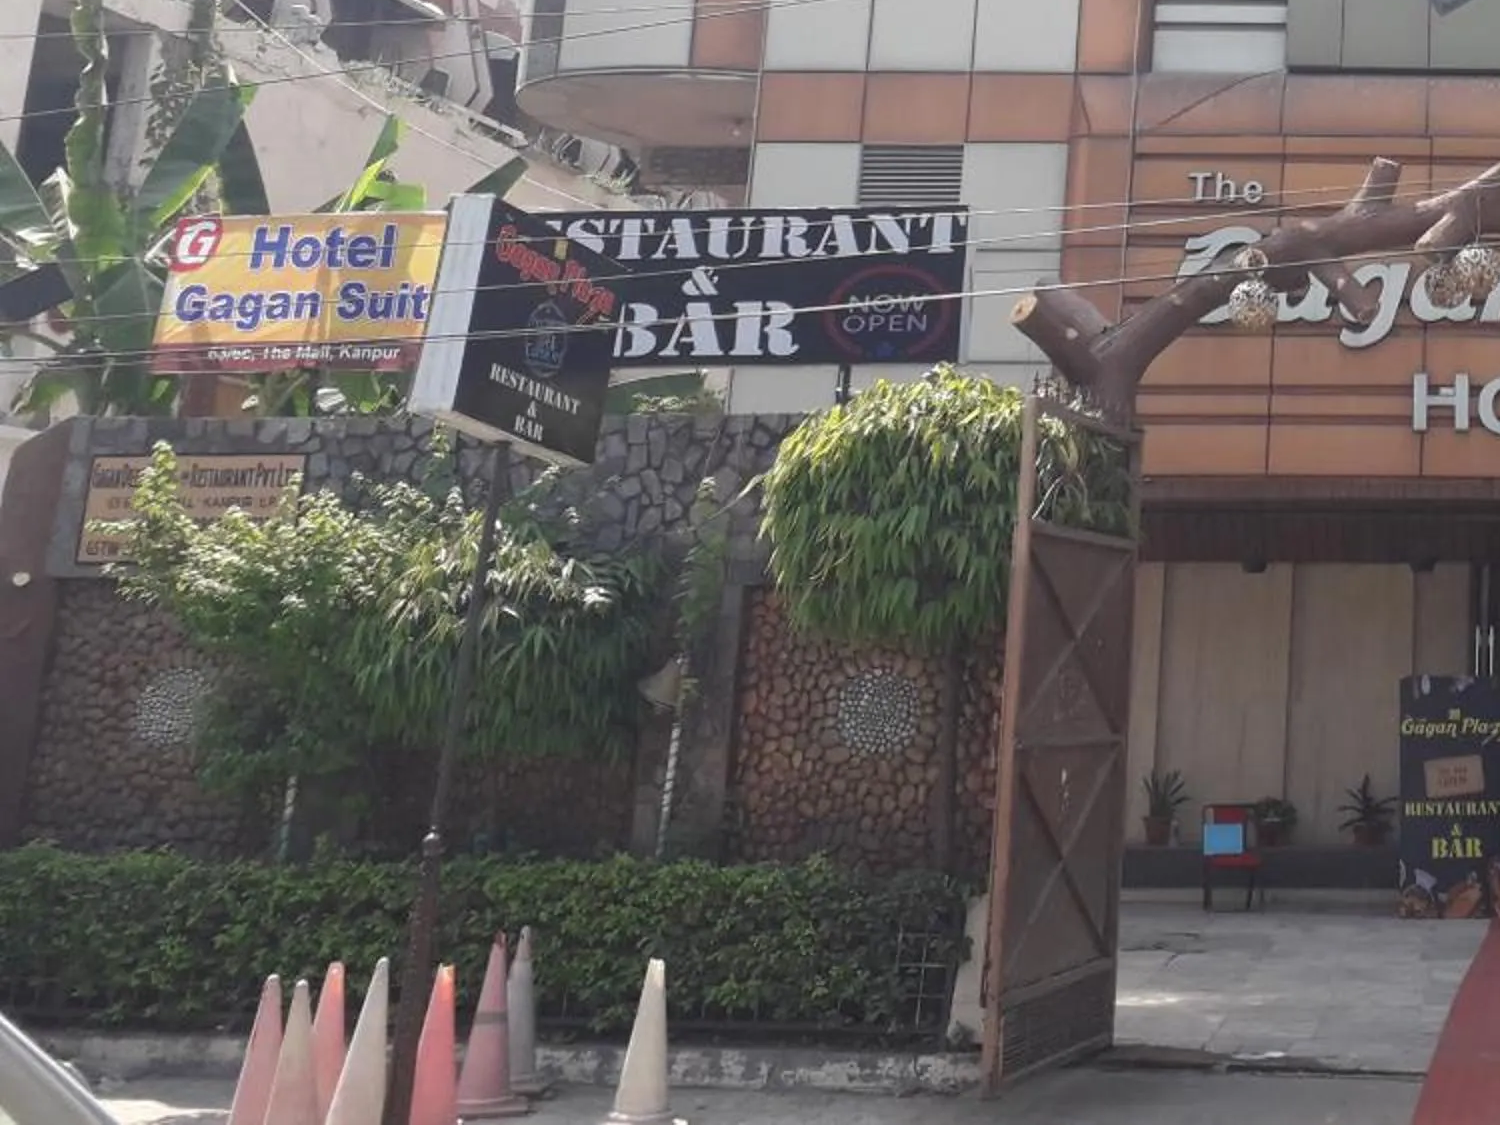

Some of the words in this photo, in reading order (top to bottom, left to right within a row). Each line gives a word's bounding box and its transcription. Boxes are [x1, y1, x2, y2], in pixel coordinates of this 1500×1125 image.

[1188, 172, 1263, 205] The
[249, 223, 398, 270] Hotel
[546, 213, 968, 262] STAURANT
[681, 265, 720, 296] &
[174, 283, 323, 332] Gagan
[336, 280, 431, 321] Suit
[848, 293, 926, 314] NOW
[611, 299, 800, 358] BAR
[842, 313, 928, 334] OPEN
[339, 343, 401, 362] Kanpur
[489, 362, 581, 415] RESTAURANT
[514, 414, 544, 442] BAR
[1401, 717, 1457, 738] Gagan
[1431, 837, 1483, 859] BAR
